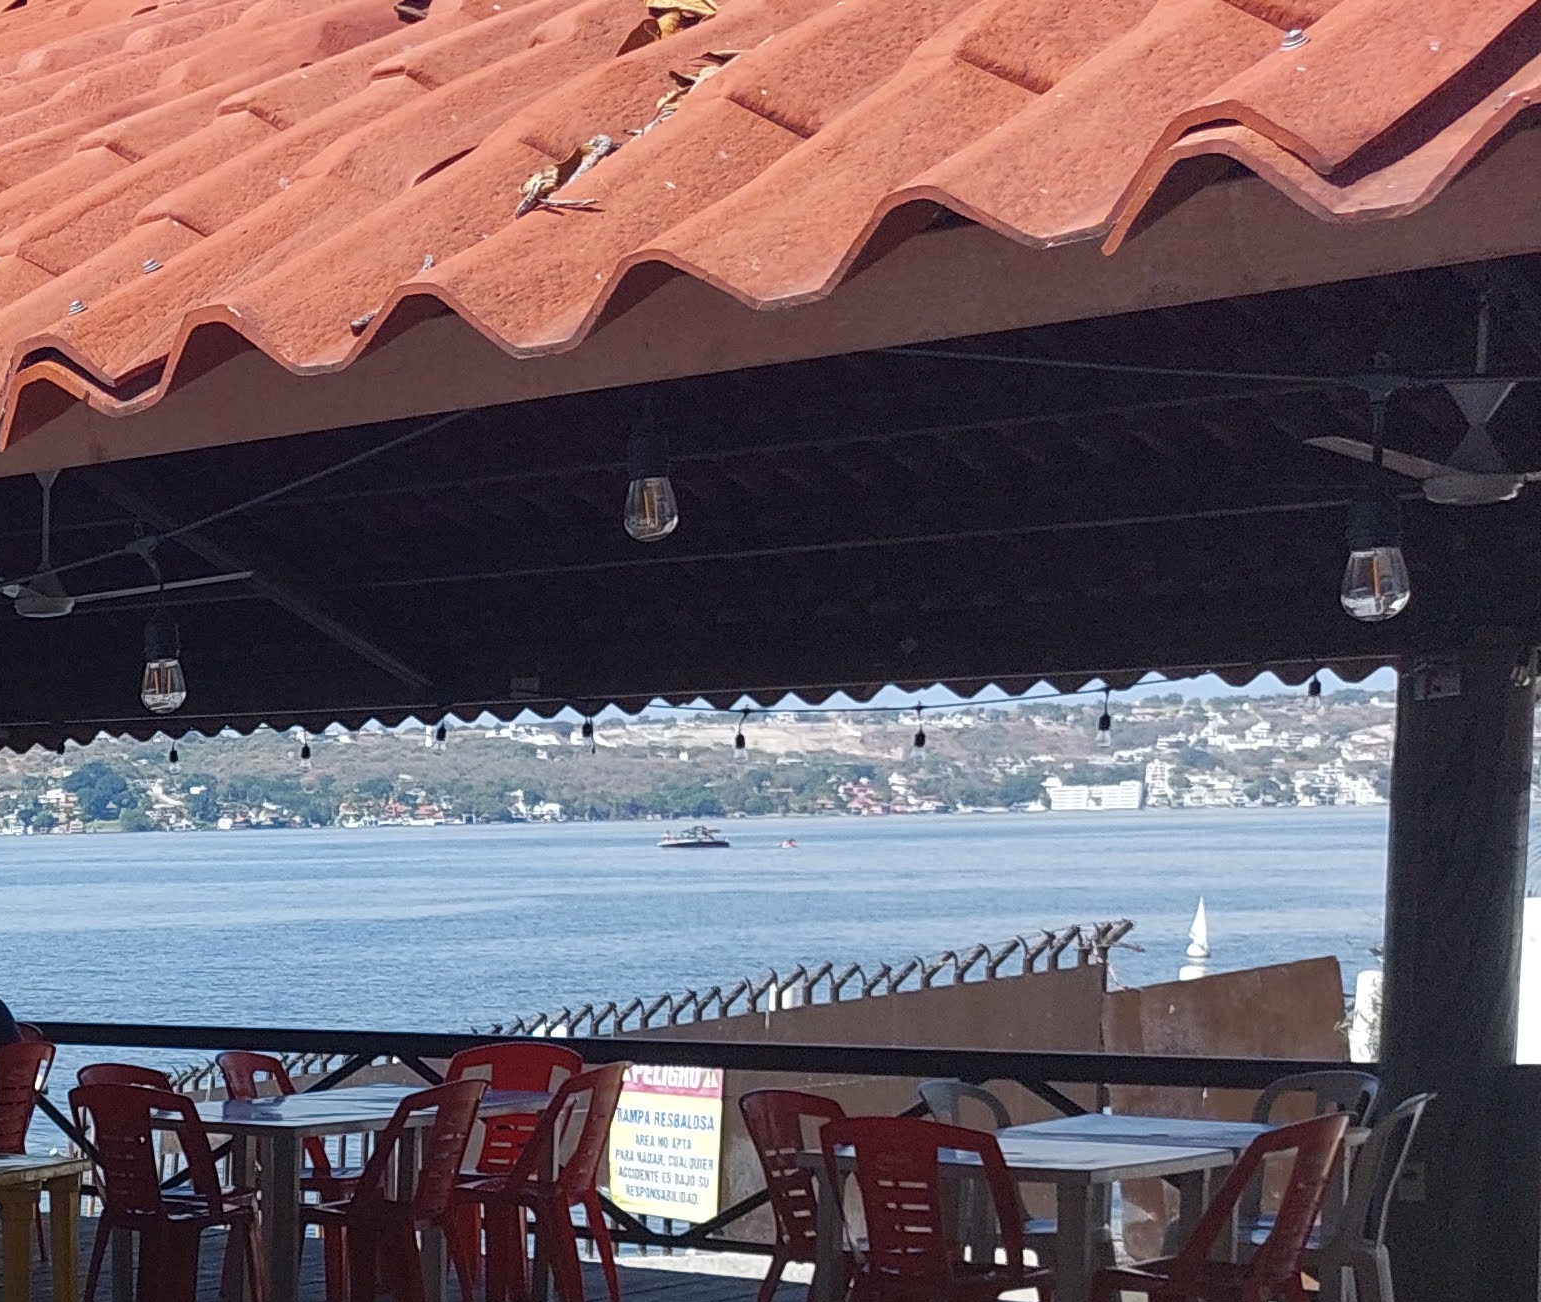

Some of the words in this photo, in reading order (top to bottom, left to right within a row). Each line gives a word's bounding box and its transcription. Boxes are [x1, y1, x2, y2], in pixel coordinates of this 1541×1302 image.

[617, 1107, 651, 1126] RAMPA
[653, 1111, 715, 1131] RESBALOSA
[658, 1136, 669, 1149] NO
[672, 1137, 692, 1150] APTA
[615, 1148, 634, 1162] PARA
[669, 1155, 714, 1171] CUALQUIER
[618, 1166, 659, 1184] ACCIDENTE
[662, 1171, 672, 1185] ES
[675, 1173, 696, 1187] BAJO
[699, 1176, 710, 1189] SU
